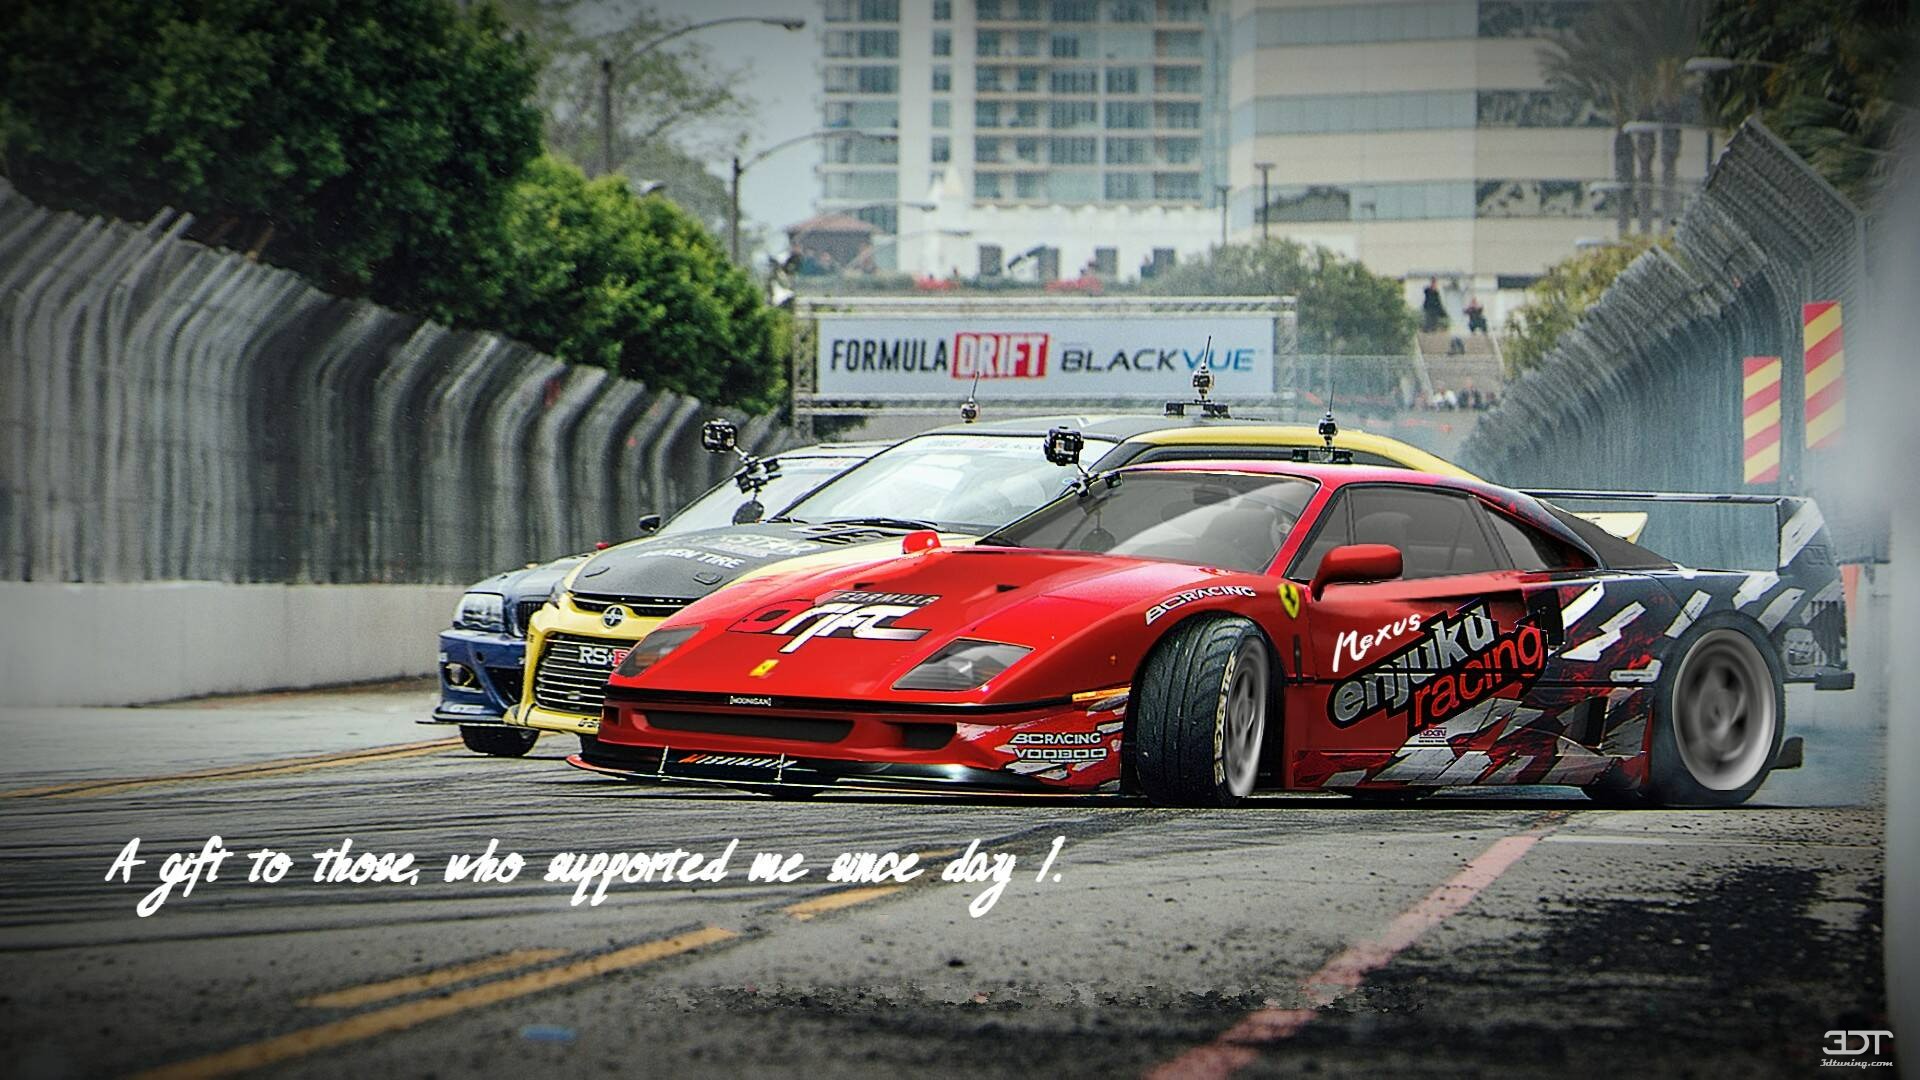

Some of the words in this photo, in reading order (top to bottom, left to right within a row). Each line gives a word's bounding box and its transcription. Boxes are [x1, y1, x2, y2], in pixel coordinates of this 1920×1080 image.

[831, 339, 947, 371] FORMULA
[957, 335, 1047, 377] DRIFT
[1061, 349, 1254, 371] BLACKVUE
[833, 592, 941, 606] FORMULA
[1333, 604, 1495, 721] enjuku
[1414, 622, 1544, 727] racing
